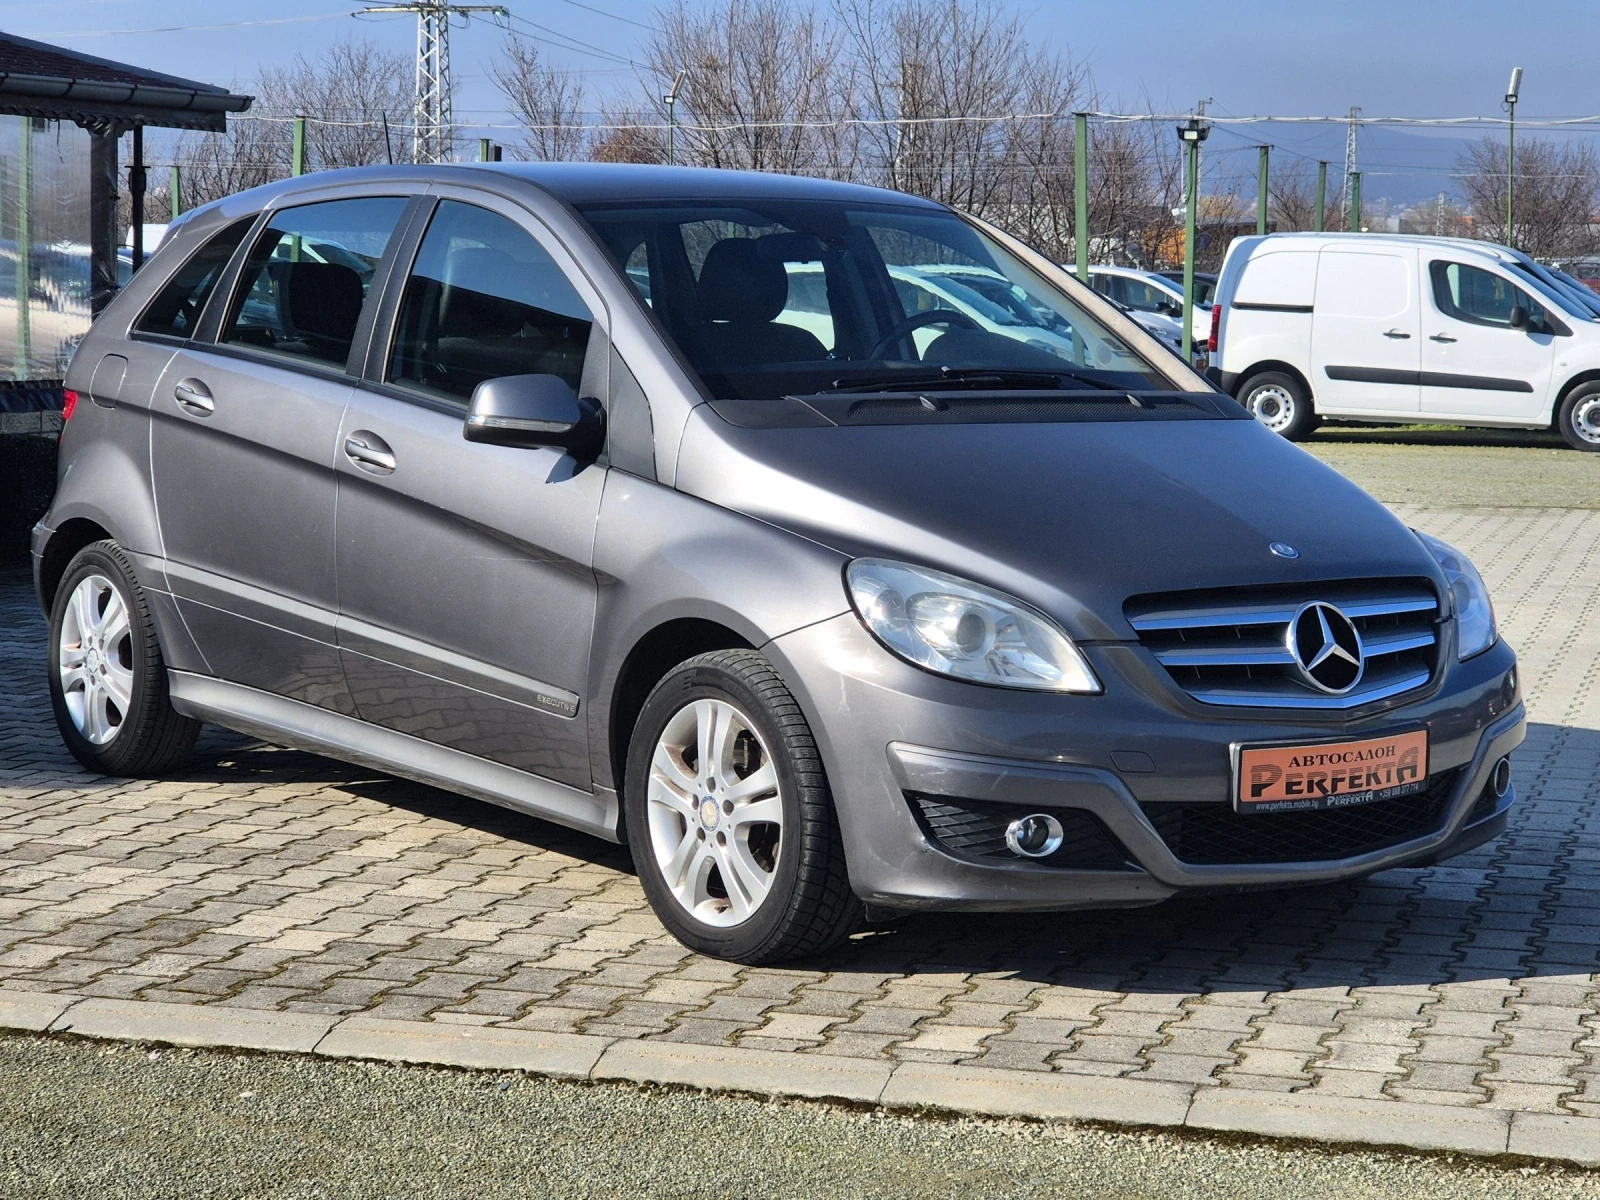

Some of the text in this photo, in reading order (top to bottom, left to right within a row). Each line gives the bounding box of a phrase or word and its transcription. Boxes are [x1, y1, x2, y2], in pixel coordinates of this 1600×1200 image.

[537, 694, 575, 712] EXECUTIVE
[1288, 745, 1396, 767] АВТОСАЛОН
[1250, 746, 1419, 797] PERFEKTA
[1256, 800, 1319, 812] www.perfekta.mobile.bg
[1327, 790, 1374, 806] PERFEKTA
